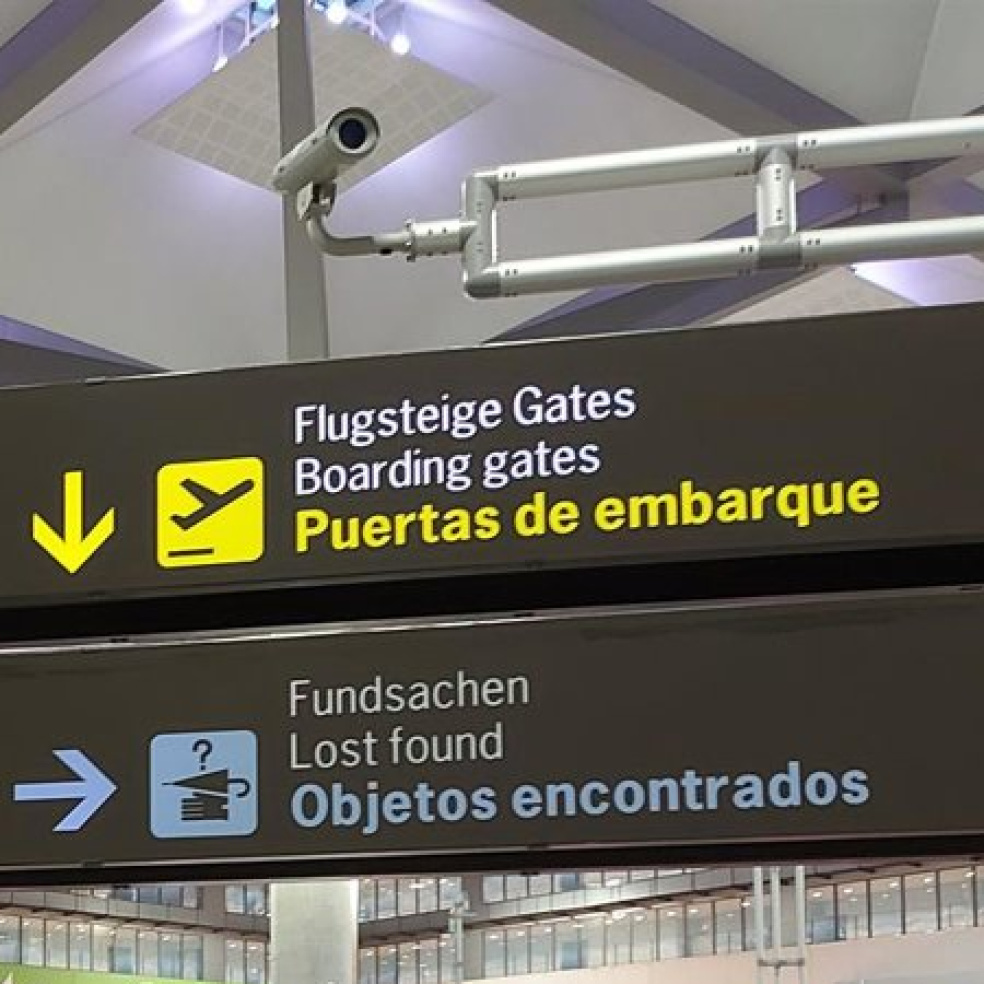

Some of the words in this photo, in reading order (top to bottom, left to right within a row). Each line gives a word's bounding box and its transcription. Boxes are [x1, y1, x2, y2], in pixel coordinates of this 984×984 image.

[294, 393, 502, 447] Flugsteige
[513, 384, 636, 425] Gates
[295, 448, 472, 495] Boarding
[482, 441, 600, 489] gates
[296, 504, 500, 552] Puertas
[515, 491, 580, 537] de
[594, 478, 880, 531] embarque
[290, 670, 528, 716] Fundsachen
[290, 730, 379, 769] Lost
[388, 721, 502, 764] found
[290, 780, 497, 834] Objetos
[511, 760, 869, 819] encontrados
